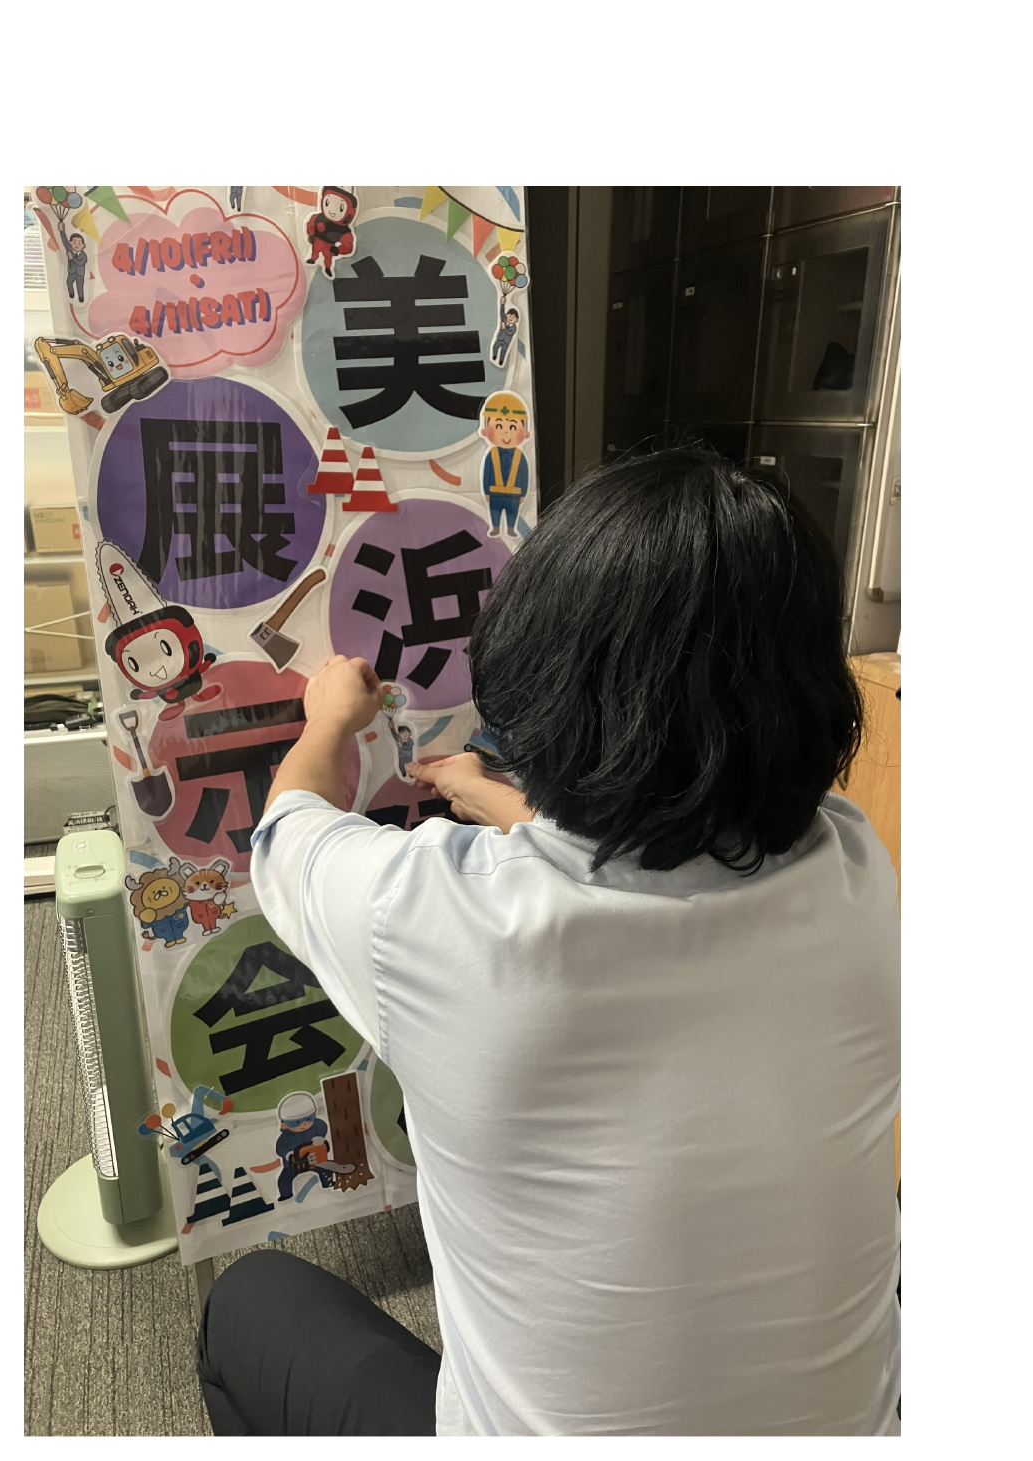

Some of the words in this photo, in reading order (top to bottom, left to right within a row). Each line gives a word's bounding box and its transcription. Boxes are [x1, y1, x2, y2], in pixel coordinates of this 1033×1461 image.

[112, 226, 256, 275] 4/10(FRI)
[129, 288, 271, 337] 4/11(SAT)
[114, 576, 140, 615] ZENOAH
